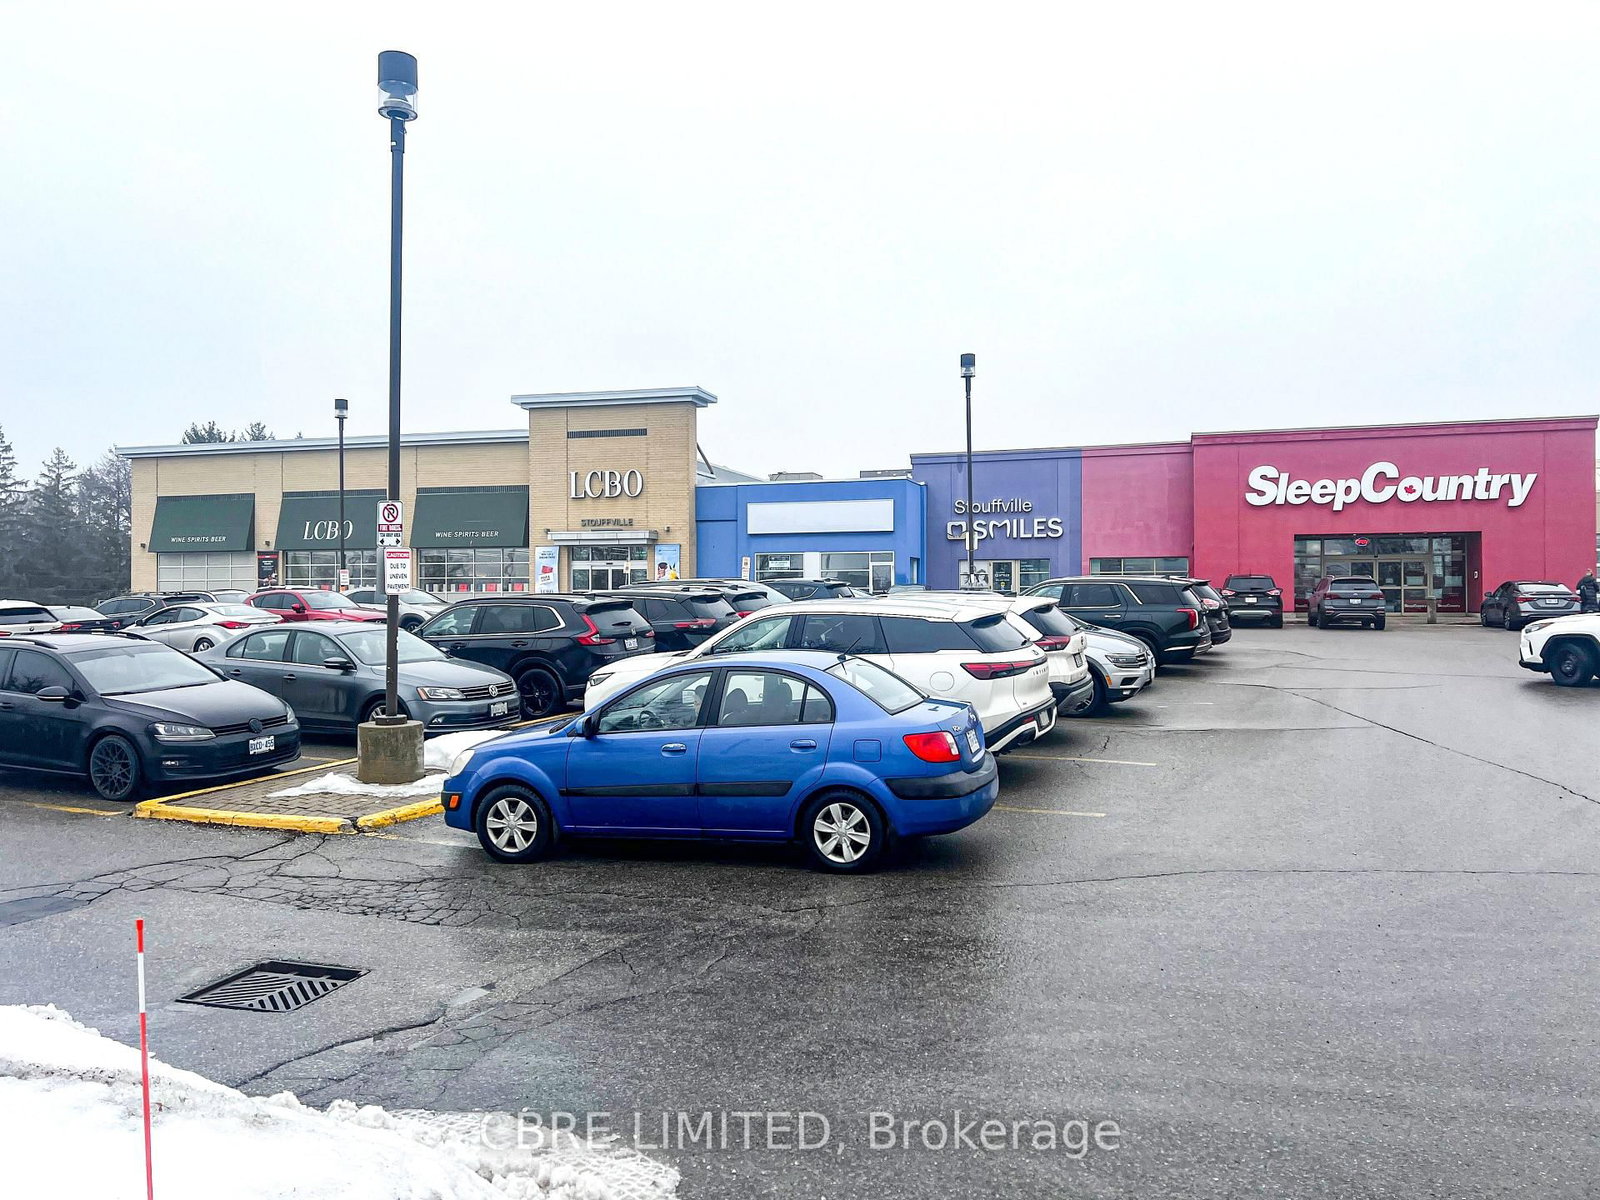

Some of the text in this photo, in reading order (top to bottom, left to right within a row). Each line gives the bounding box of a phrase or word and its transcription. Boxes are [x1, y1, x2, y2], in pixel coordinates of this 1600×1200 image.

[570, 469, 643, 499] LCBO
[1245, 461, 1538, 511] SleepCountry
[303, 519, 354, 540] LCBO
[581, 518, 634, 527] STOUFFVILLE
[973, 517, 1064, 540] SMILES
